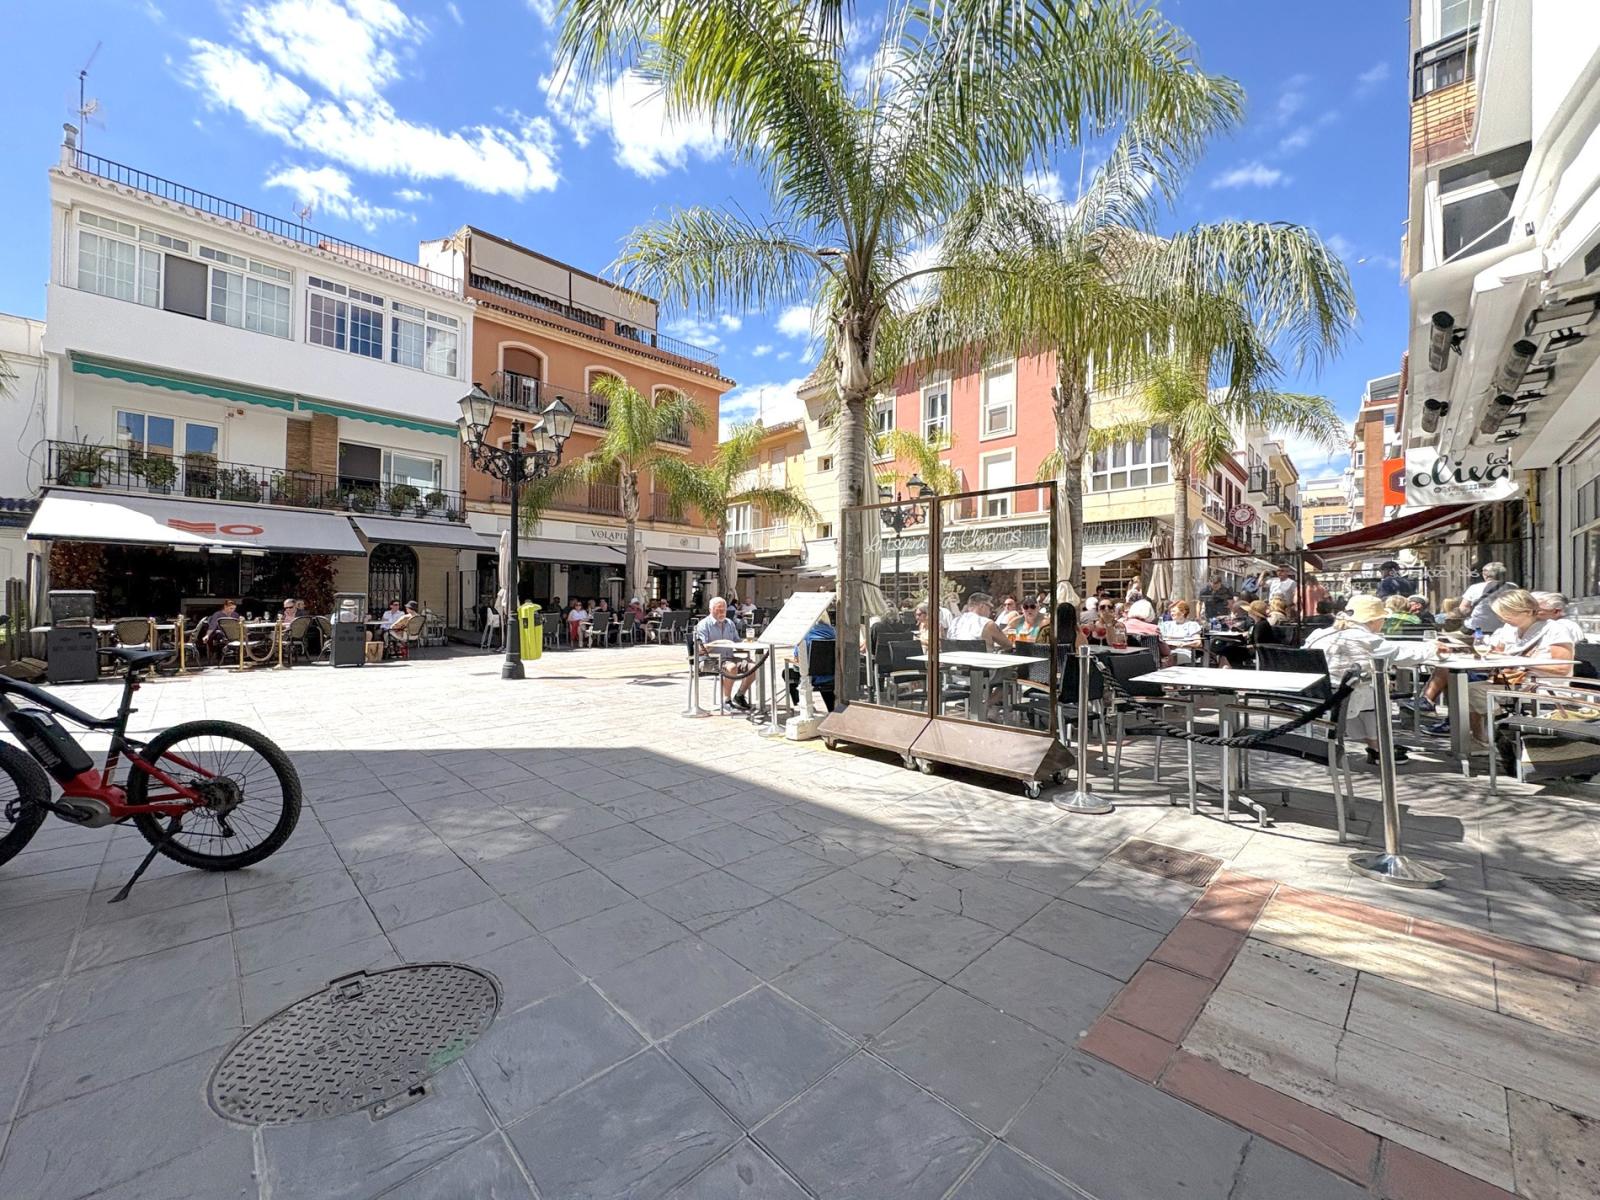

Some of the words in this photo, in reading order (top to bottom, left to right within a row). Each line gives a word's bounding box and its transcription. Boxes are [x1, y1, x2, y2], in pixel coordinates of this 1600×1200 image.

[1411, 455, 1510, 488] oliva
[887, 533, 925, 554] Esquina
[942, 532, 956, 549] de
